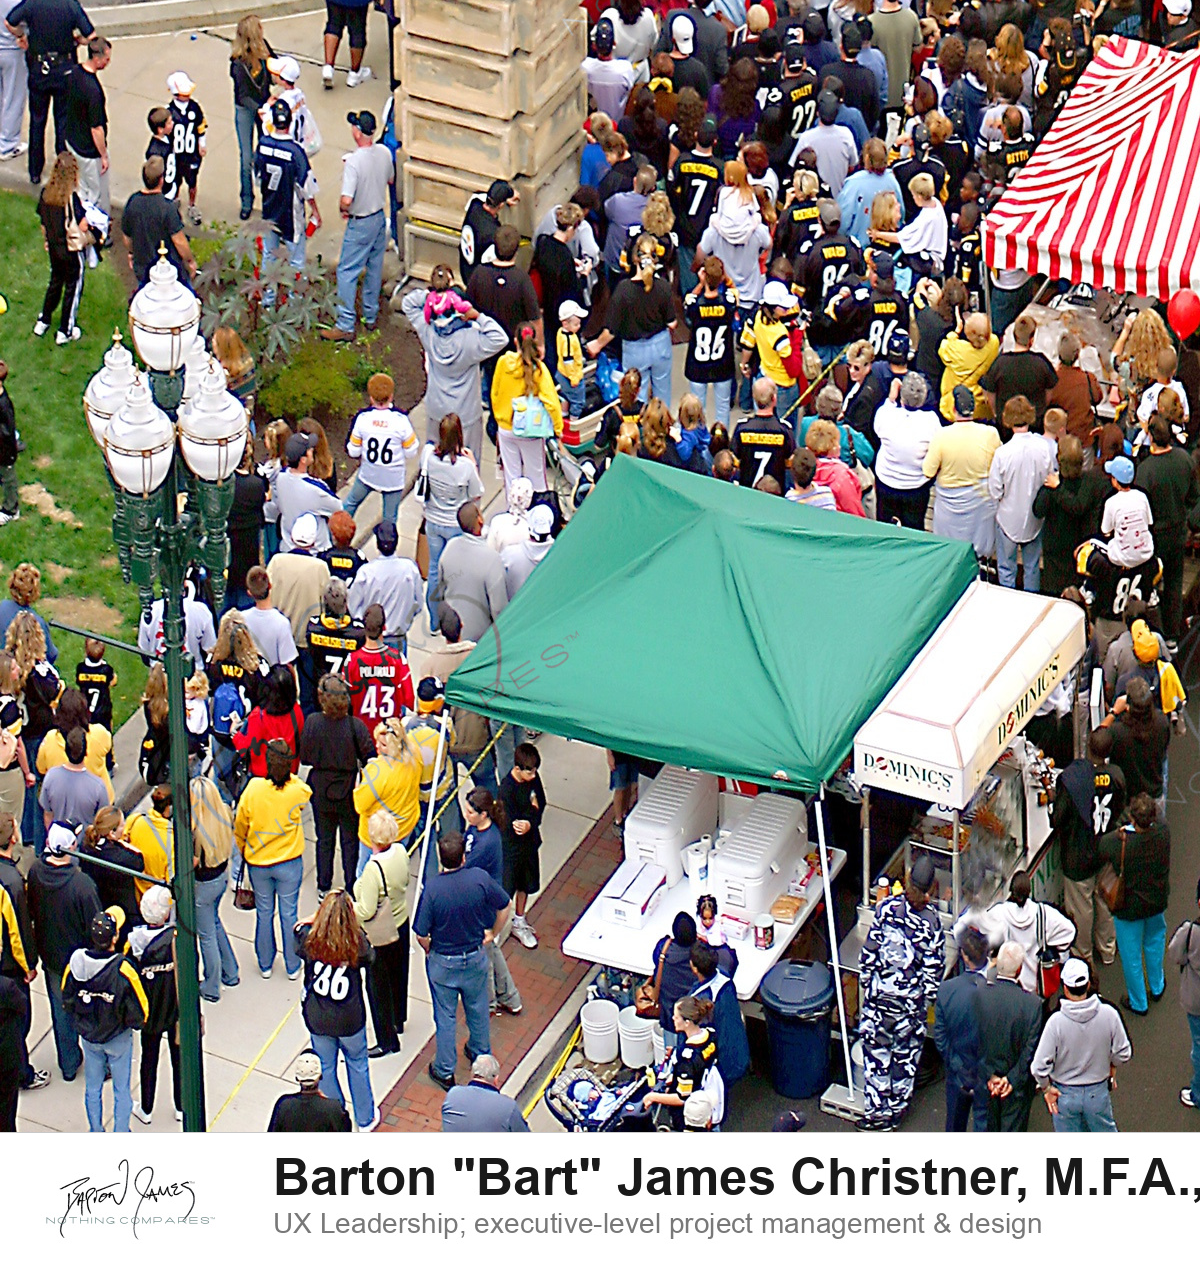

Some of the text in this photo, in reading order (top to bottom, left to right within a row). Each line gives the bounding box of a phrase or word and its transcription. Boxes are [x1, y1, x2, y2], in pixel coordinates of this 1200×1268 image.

[174, 122, 195, 153] 86
[265, 163, 282, 191] 7
[688, 178, 708, 215] 7
[699, 305, 726, 317] WARD
[874, 303, 896, 314] WARD
[695, 325, 728, 362] 86
[367, 437, 393, 464] 86
[754, 452, 772, 482] 7
[325, 655, 343, 674] 7
[88, 688, 100, 712] 7
[360, 685, 395, 719] 43
[998, 653, 1061, 745] DOMINIC'S
[863, 752, 953, 789] DOMINIC'S
[1095, 774, 1111, 787] ARD
[313, 961, 349, 1000] 86
